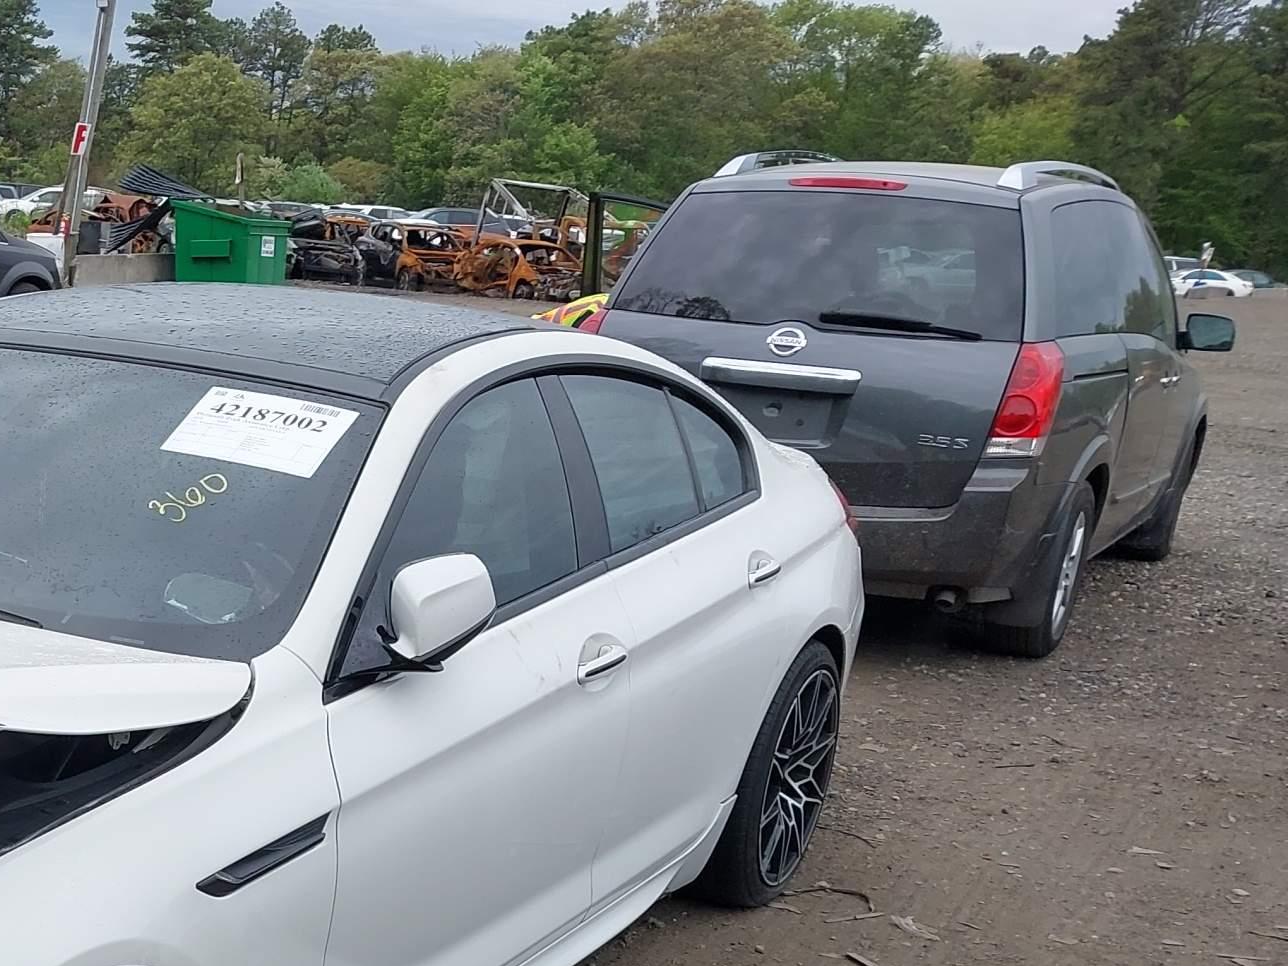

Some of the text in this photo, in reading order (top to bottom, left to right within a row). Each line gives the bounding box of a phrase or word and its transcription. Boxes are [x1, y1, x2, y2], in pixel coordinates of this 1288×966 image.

[73, 124, 88, 154] F
[210, 403, 328, 432] 42187002
[148, 473, 228, 522] 360
